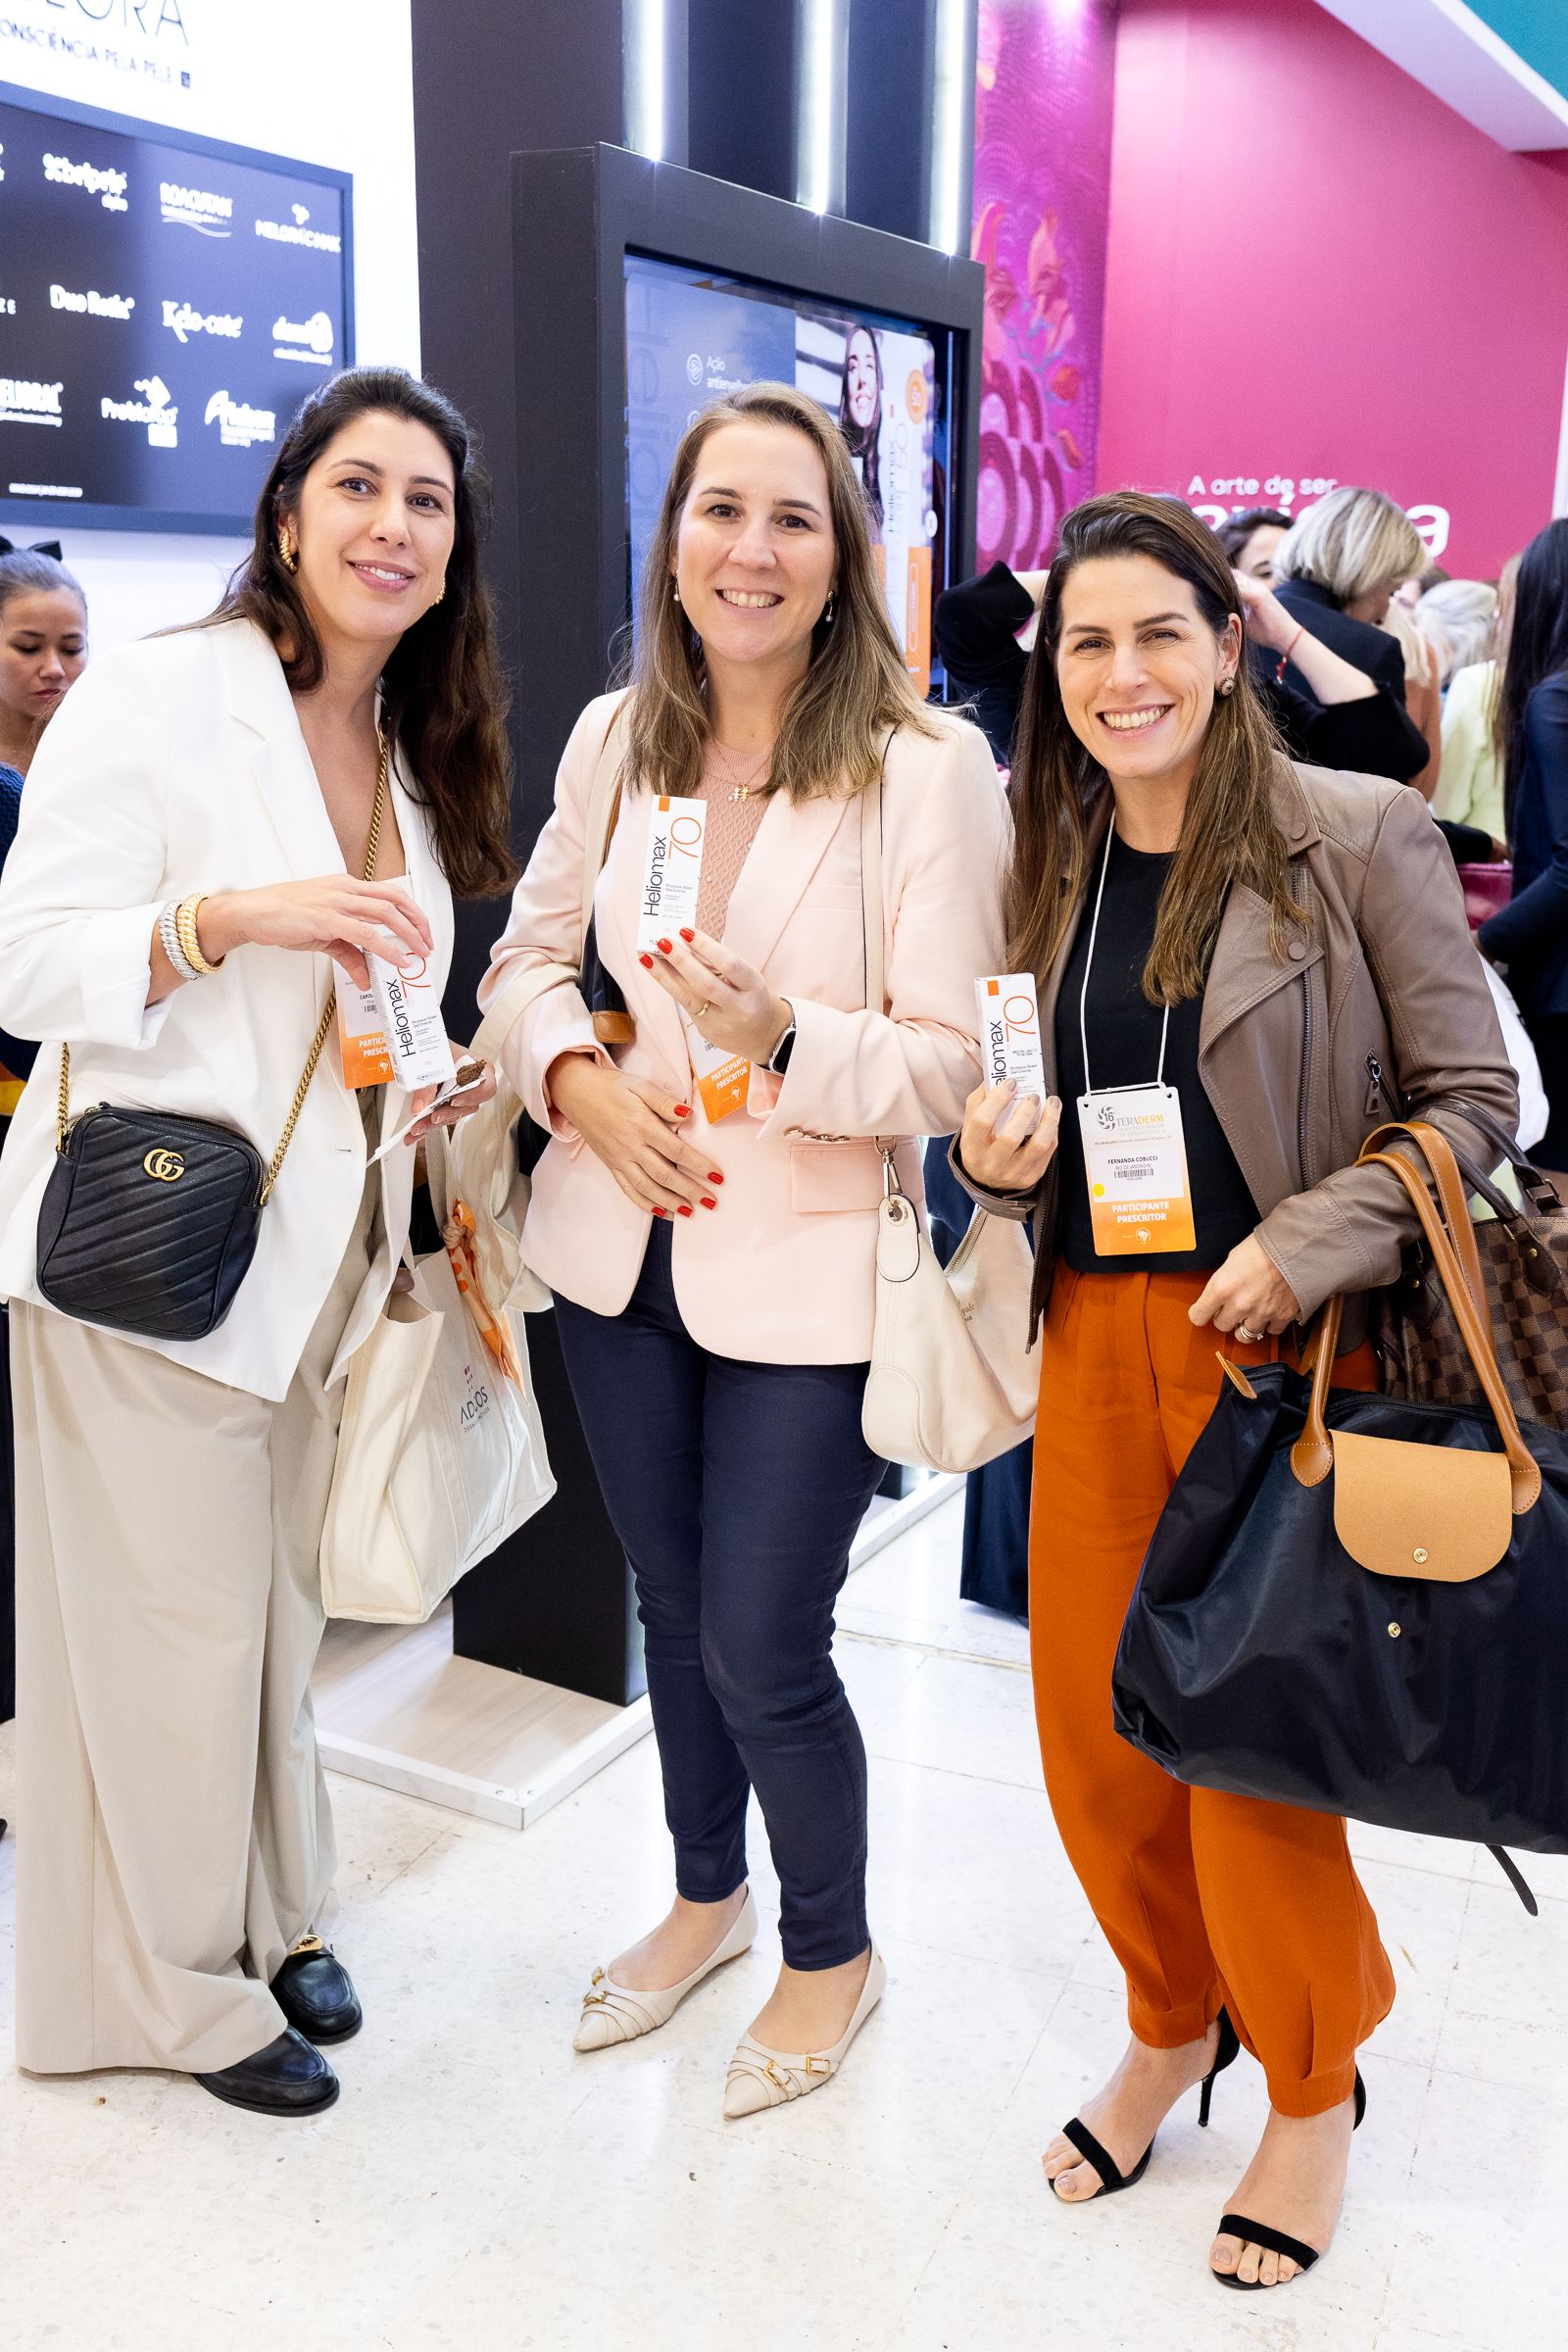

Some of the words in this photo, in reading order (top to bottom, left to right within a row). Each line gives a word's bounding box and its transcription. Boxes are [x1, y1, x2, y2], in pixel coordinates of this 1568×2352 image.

[105, 48, 137, 73] PELA
[143, 60, 172, 85] PELE
[1187, 474, 1206, 496] A
[1210, 475, 1260, 496] arte
[1264, 474, 1295, 496] de
[1298, 477, 1339, 496] ser
[667, 816, 702, 859] 70
[643, 835, 667, 916] Heliomax
[397, 953, 431, 999] 70
[386, 978, 416, 1058] Heliomax
[1003, 996, 1037, 1043] 70
[363, 1046, 390, 1058] PRESCR
[716, 1065, 748, 1090] PRESCRITOR
[1103, 1111, 1114, 1122] 16
[1116, 1113, 1165, 1127] TERADERM
[1111, 1200, 1170, 1213] PARTICIPANTE
[1116, 1212, 1167, 1224] PRESCRITOR
